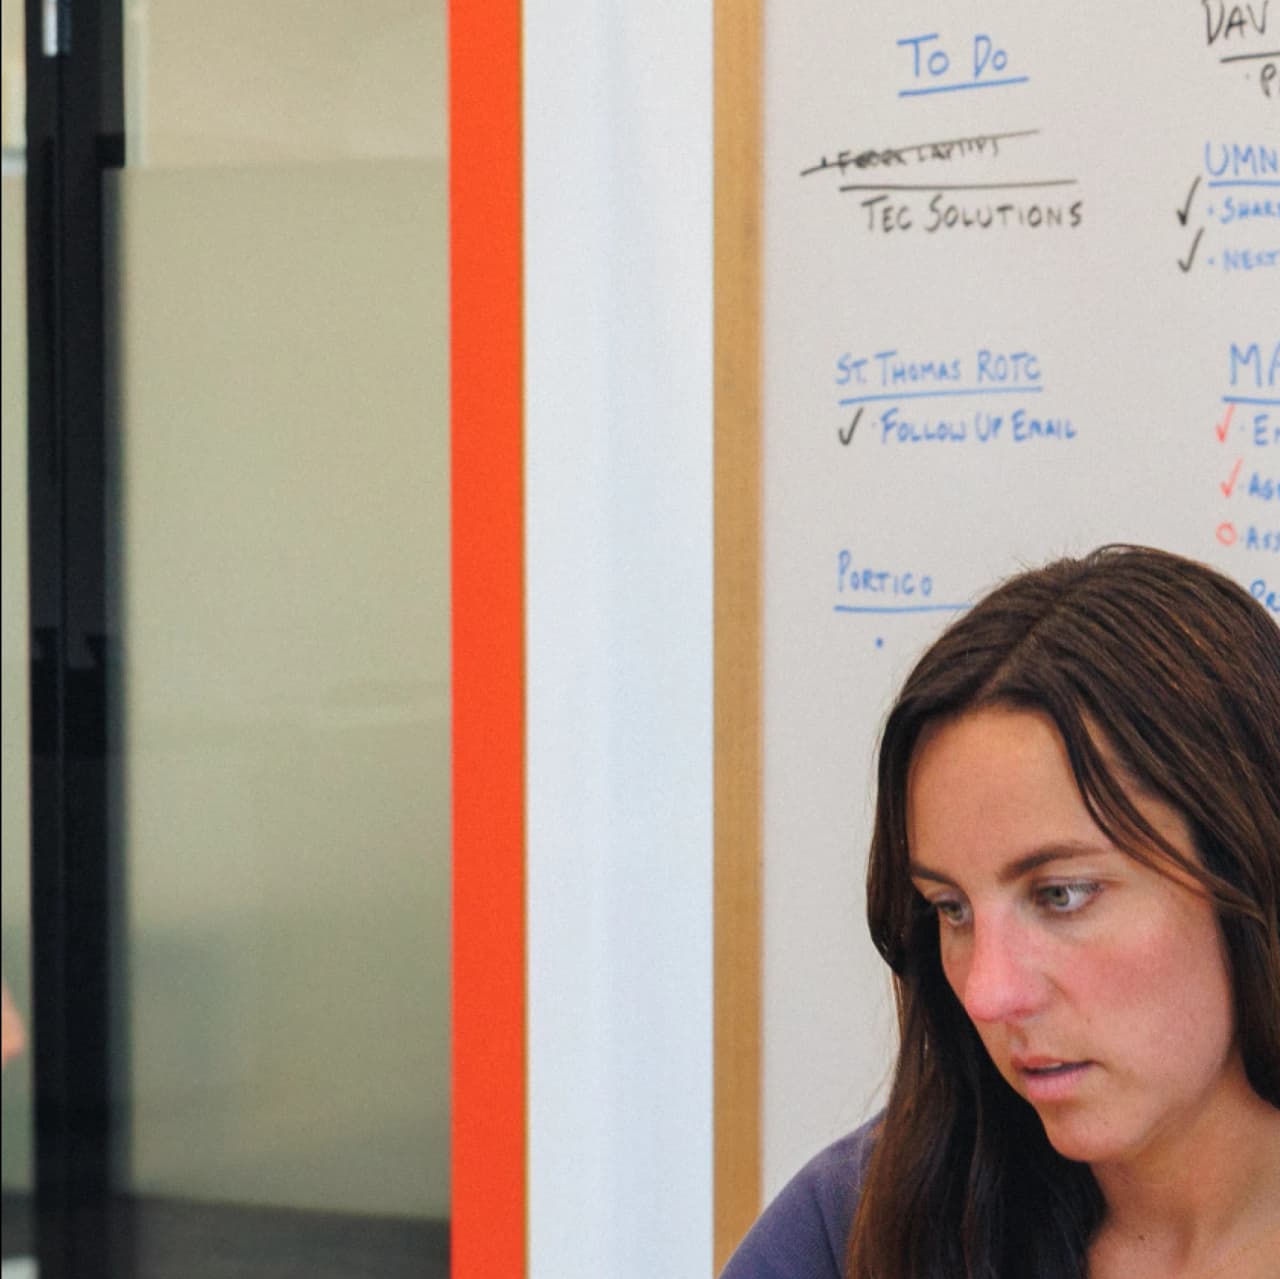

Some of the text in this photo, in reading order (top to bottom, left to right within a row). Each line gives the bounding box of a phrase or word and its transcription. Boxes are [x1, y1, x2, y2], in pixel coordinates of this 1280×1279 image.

[1203, 139, 1279, 178] UMN
[860, 193, 1084, 234] TEC SOLUTIONS
[874, 348, 961, 386] THOMAS
[976, 349, 1042, 384] ROTC
[880, 407, 1078, 445] FOLLOW UP EMAIL
[837, 548, 933, 597] PORTICO
